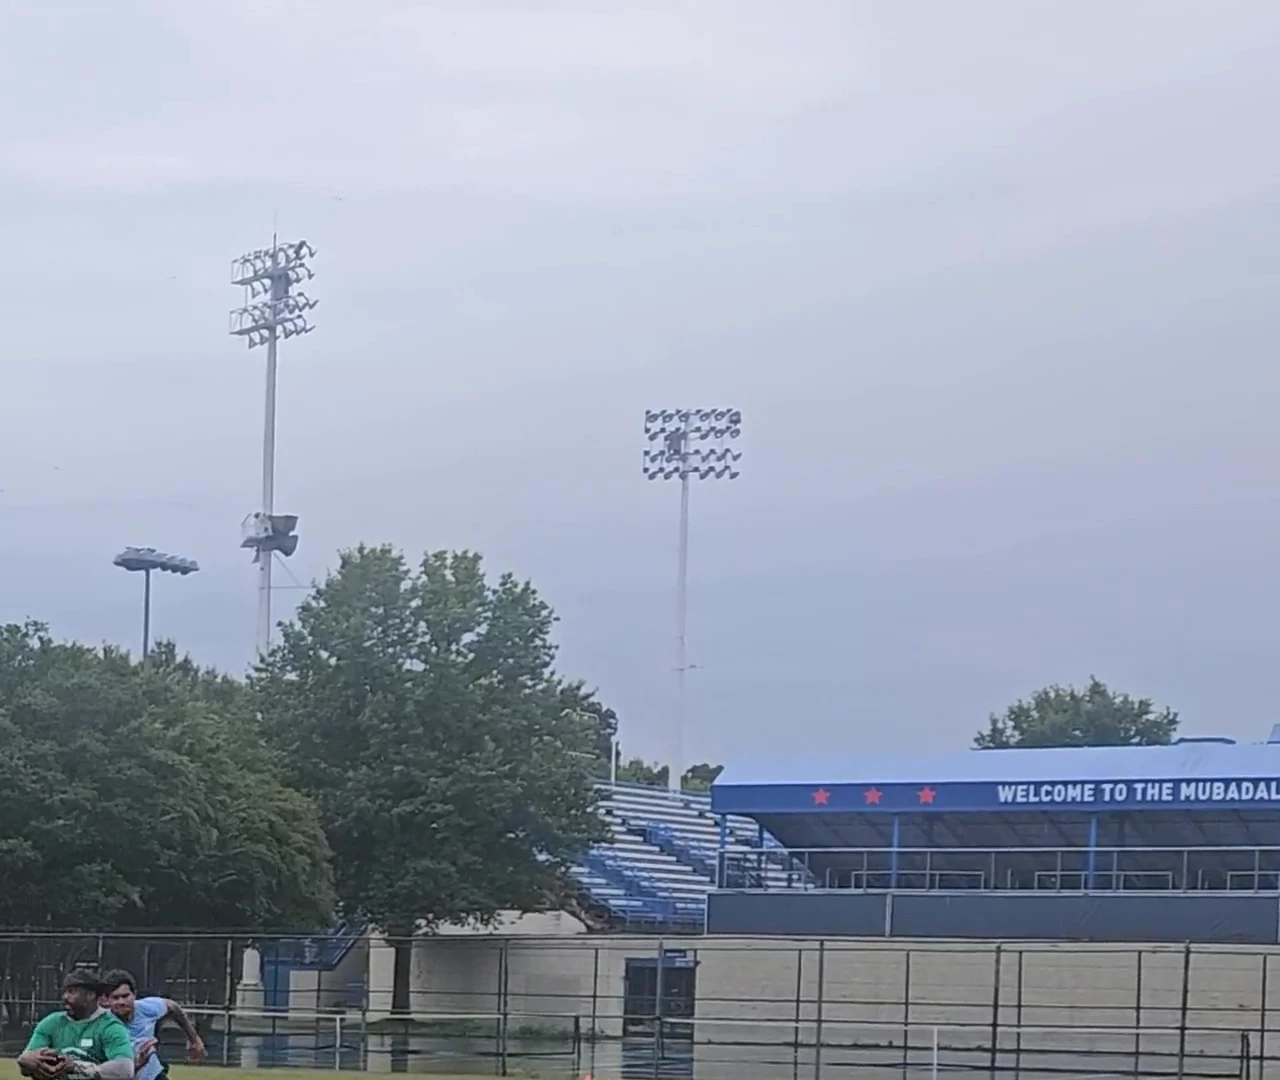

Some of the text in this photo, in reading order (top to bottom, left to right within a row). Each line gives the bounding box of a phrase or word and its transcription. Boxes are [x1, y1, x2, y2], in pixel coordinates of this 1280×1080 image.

[997, 781, 1280, 803] WELCOME TO THE MUBADAL
